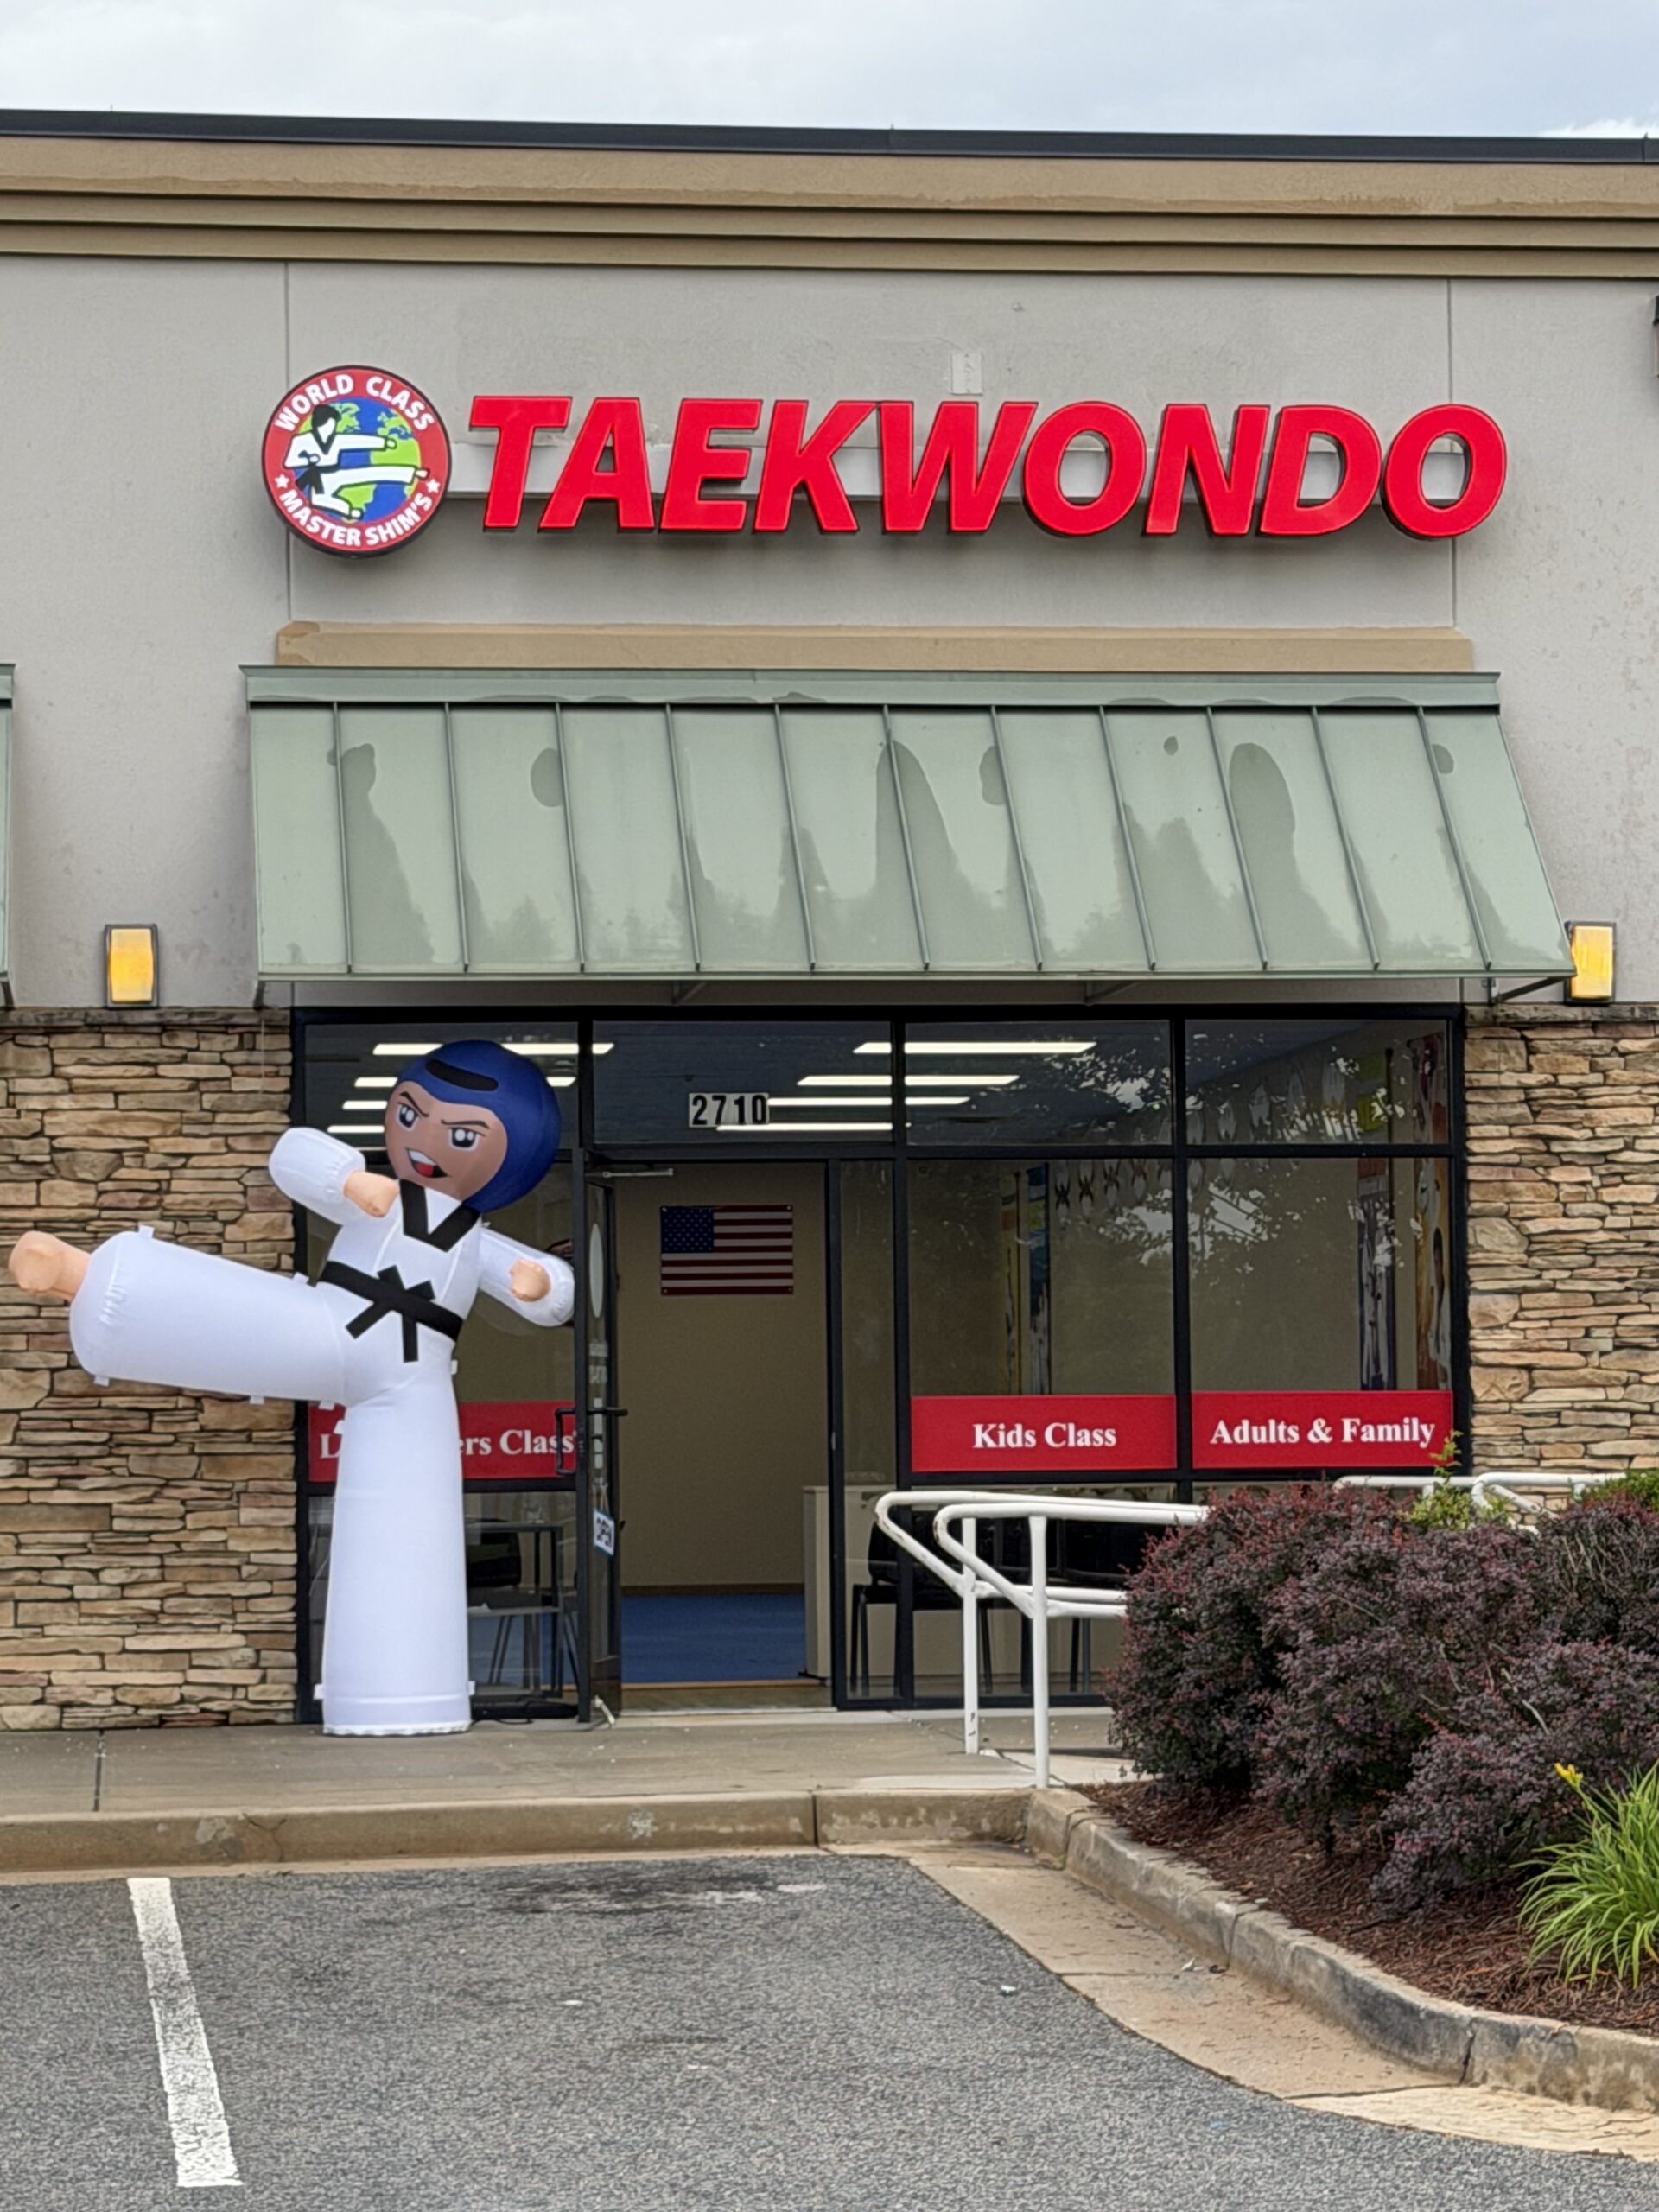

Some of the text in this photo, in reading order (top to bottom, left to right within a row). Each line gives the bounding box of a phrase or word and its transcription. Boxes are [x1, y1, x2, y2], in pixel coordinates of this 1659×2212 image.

[274, 373, 435, 432] WORLD CLASS
[469, 395, 1507, 538] TAEKWONDO
[279, 488, 434, 547] MASTER SHIM'S
[692, 1095, 766, 1125] 2710
[972, 1421, 1117, 1449] Kids Class
[1209, 1416, 1436, 1449] Adults & Family
